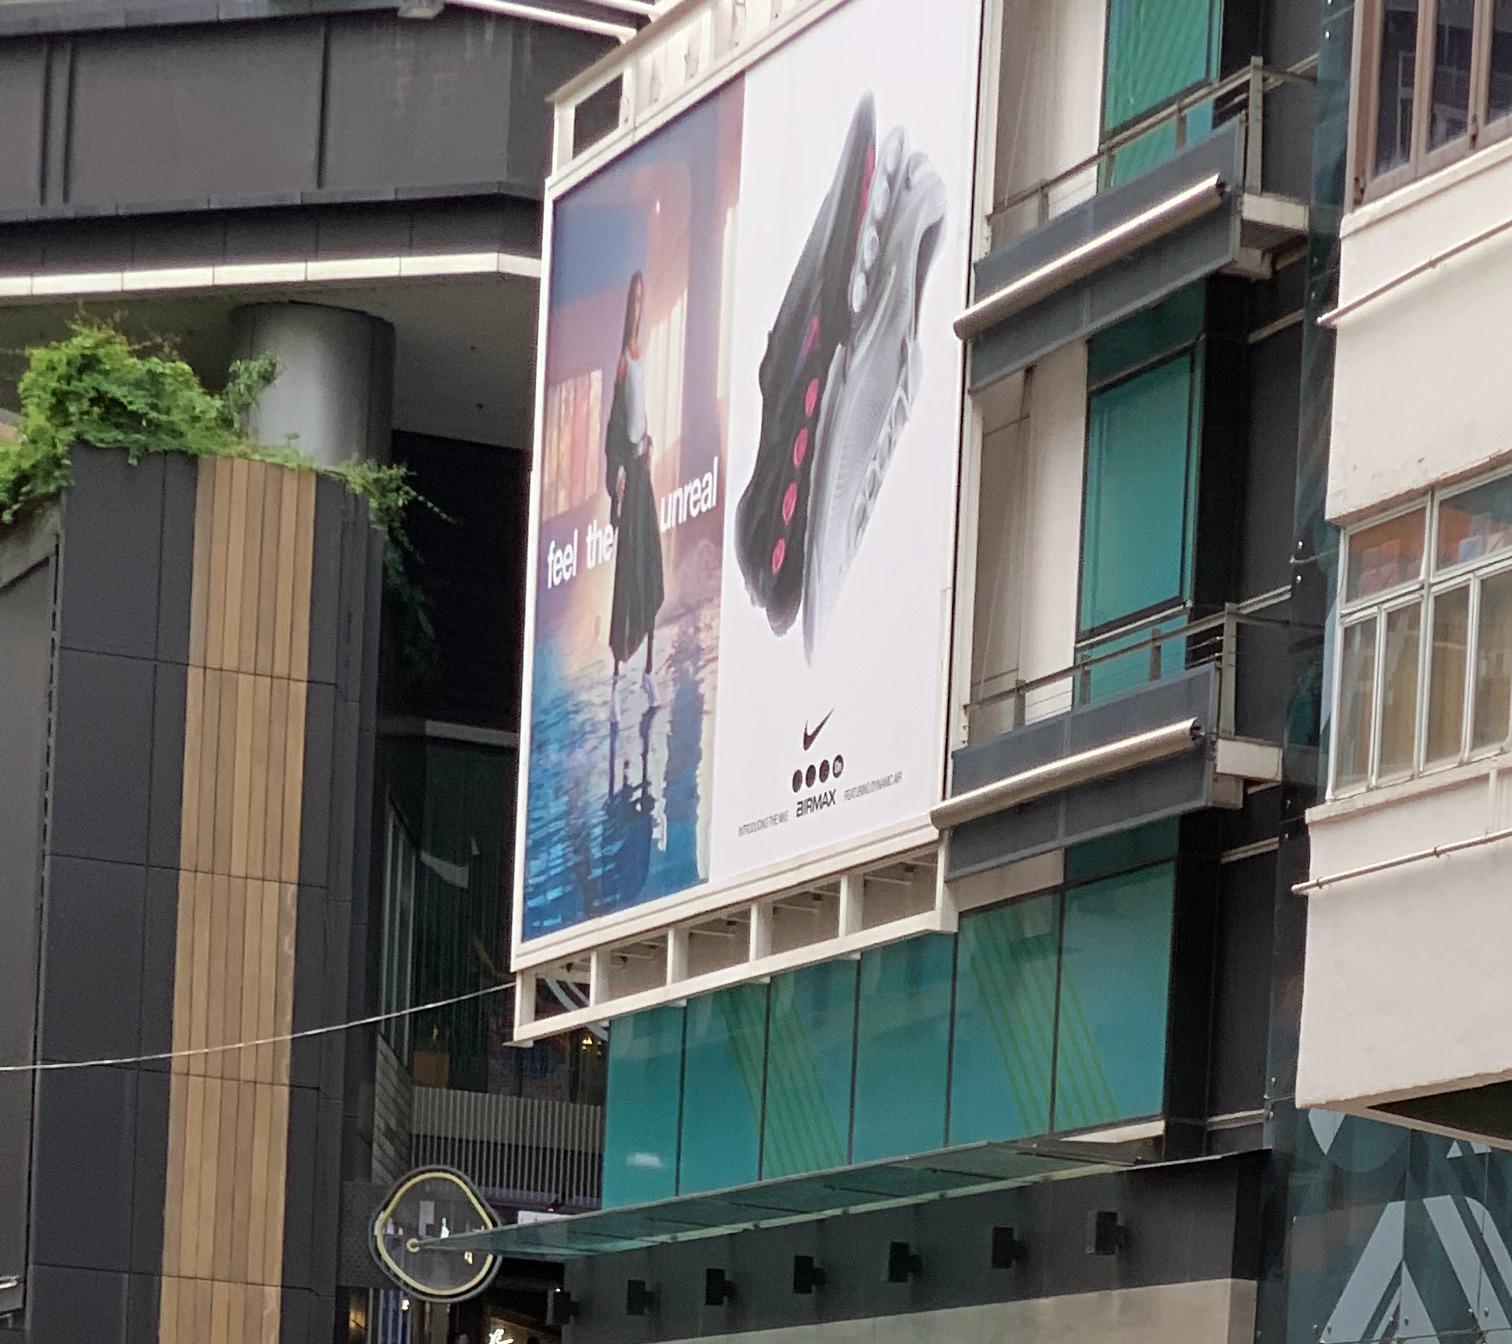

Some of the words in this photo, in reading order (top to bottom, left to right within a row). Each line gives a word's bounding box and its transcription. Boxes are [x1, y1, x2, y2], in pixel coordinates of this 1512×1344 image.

[547, 528, 578, 590] feel
[585, 519, 614, 570] the
[659, 456, 719, 533] unreal
